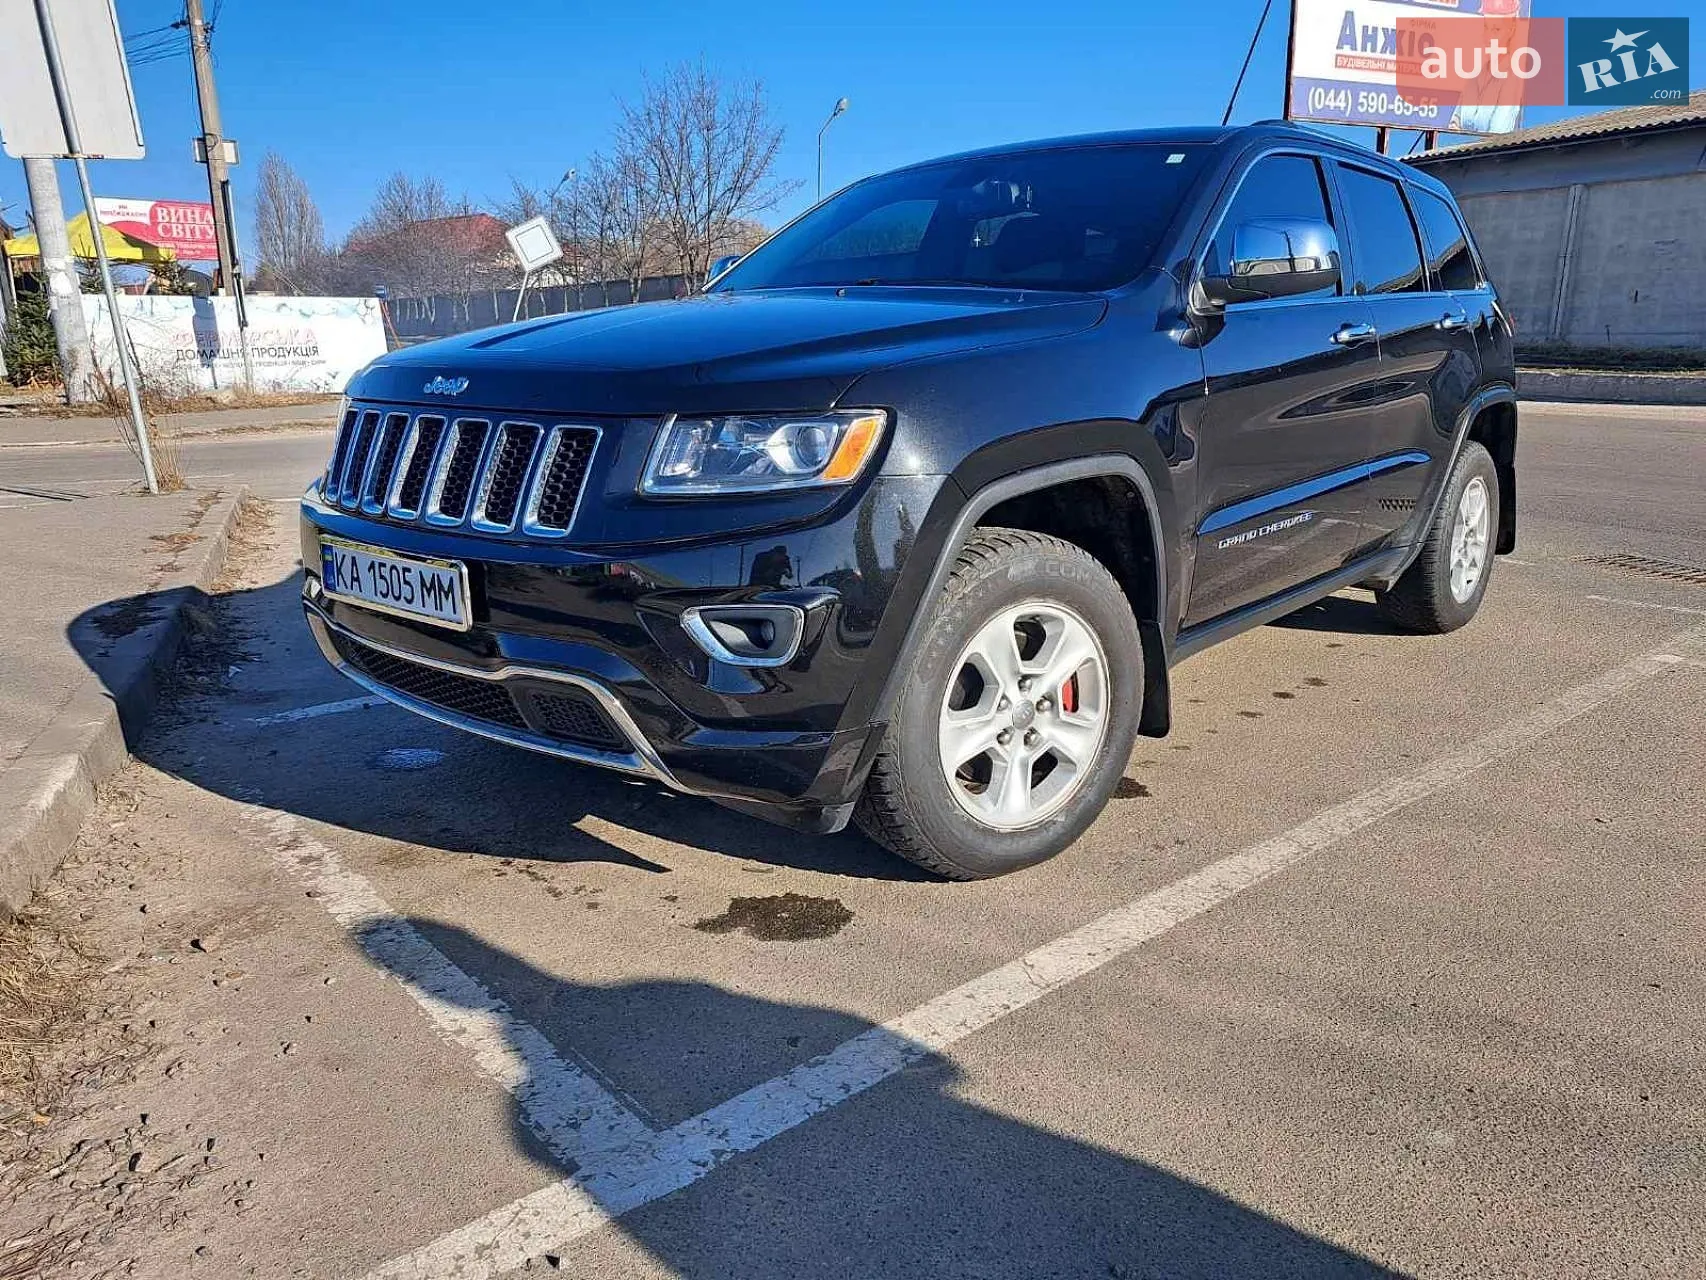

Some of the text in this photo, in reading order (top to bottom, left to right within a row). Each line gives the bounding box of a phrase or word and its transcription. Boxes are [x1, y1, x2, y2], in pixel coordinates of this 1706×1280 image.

[1307, 86, 1439, 118] (044) 590-65-55
[156, 207, 213, 225] ВИНА
[156, 223, 216, 239] СВІТУ
[251, 344, 320, 359] ПРОДУКЦІЯ
[423, 375, 470, 397] Jeep
[1218, 511, 1314, 550] GRAND CHEROKEE
[334, 551, 457, 615] KA 1505 MM
